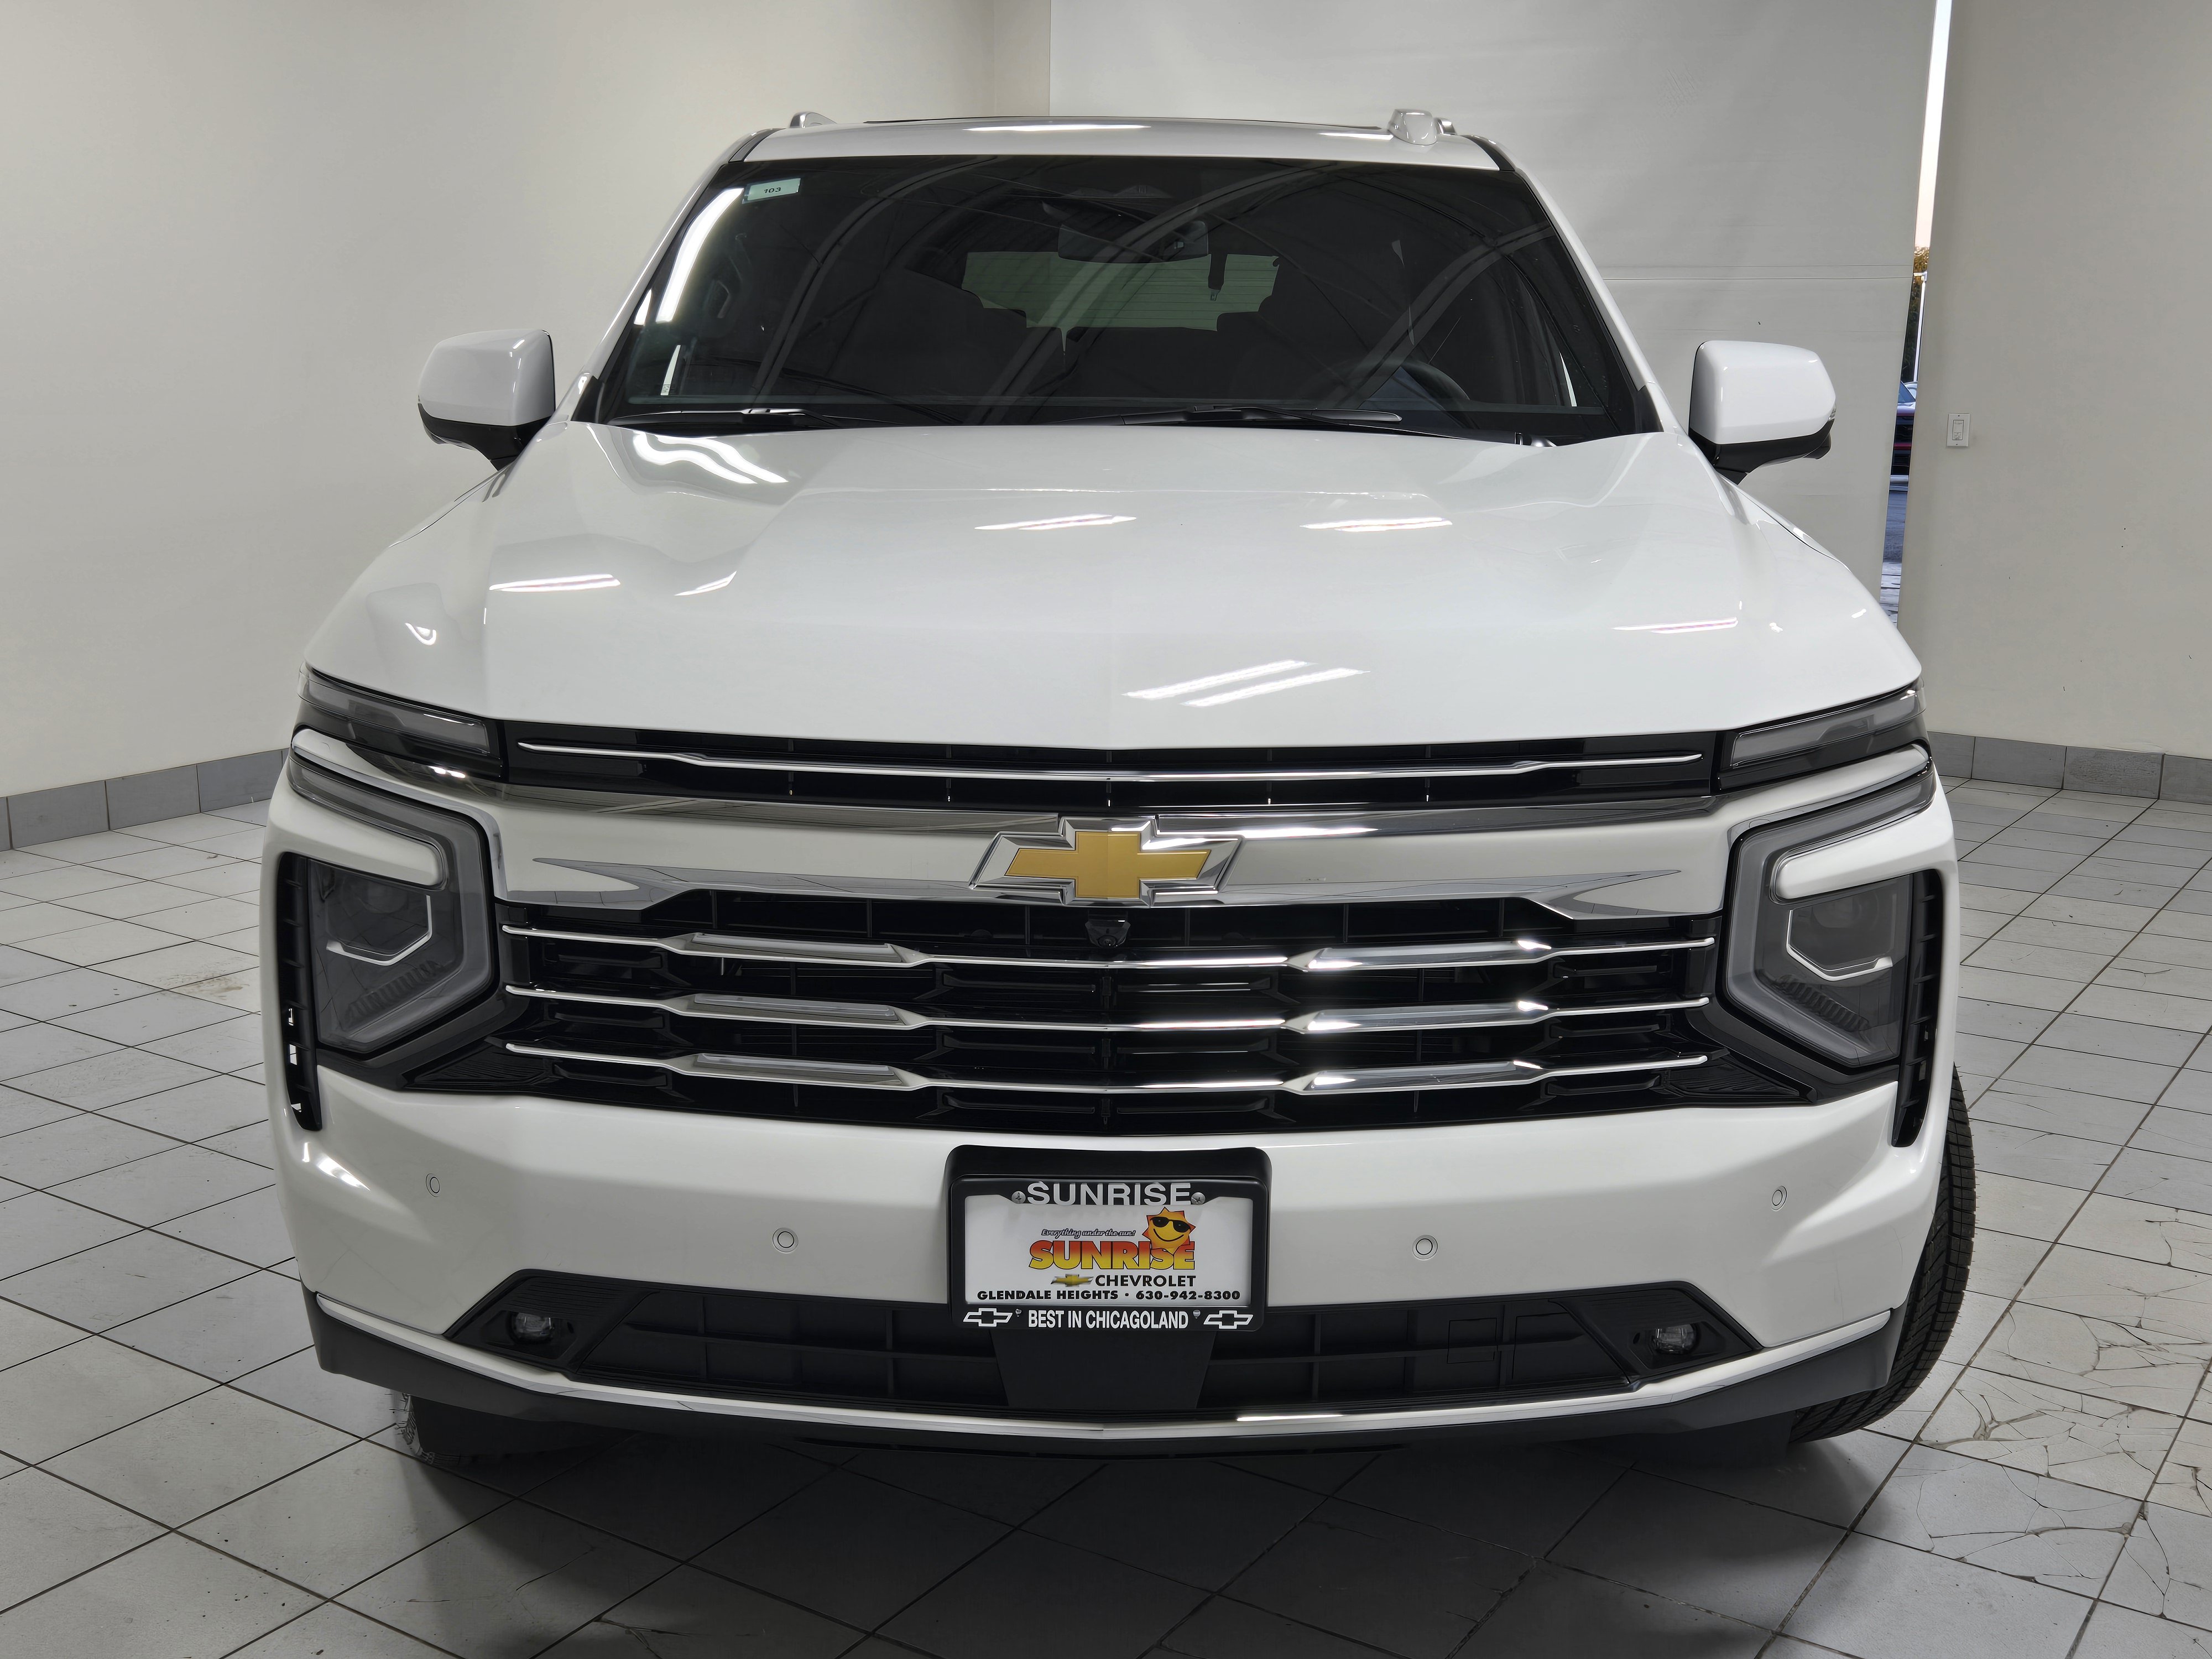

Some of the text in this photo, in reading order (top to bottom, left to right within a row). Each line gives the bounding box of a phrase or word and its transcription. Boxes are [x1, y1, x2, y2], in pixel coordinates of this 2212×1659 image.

[1027, 1181, 1191, 1205] SUNRISE
[1041, 1228, 1081, 1239] Everything
[1029, 1240, 1195, 1270] SUNRISE
[1095, 1275, 1196, 1287] CHEVROLET
[977, 1290, 1240, 1300] GLENDALE HEIGHTS 630-942-8300
[1029, 1310, 1188, 1329] BEST IN CHICAGOLAND
